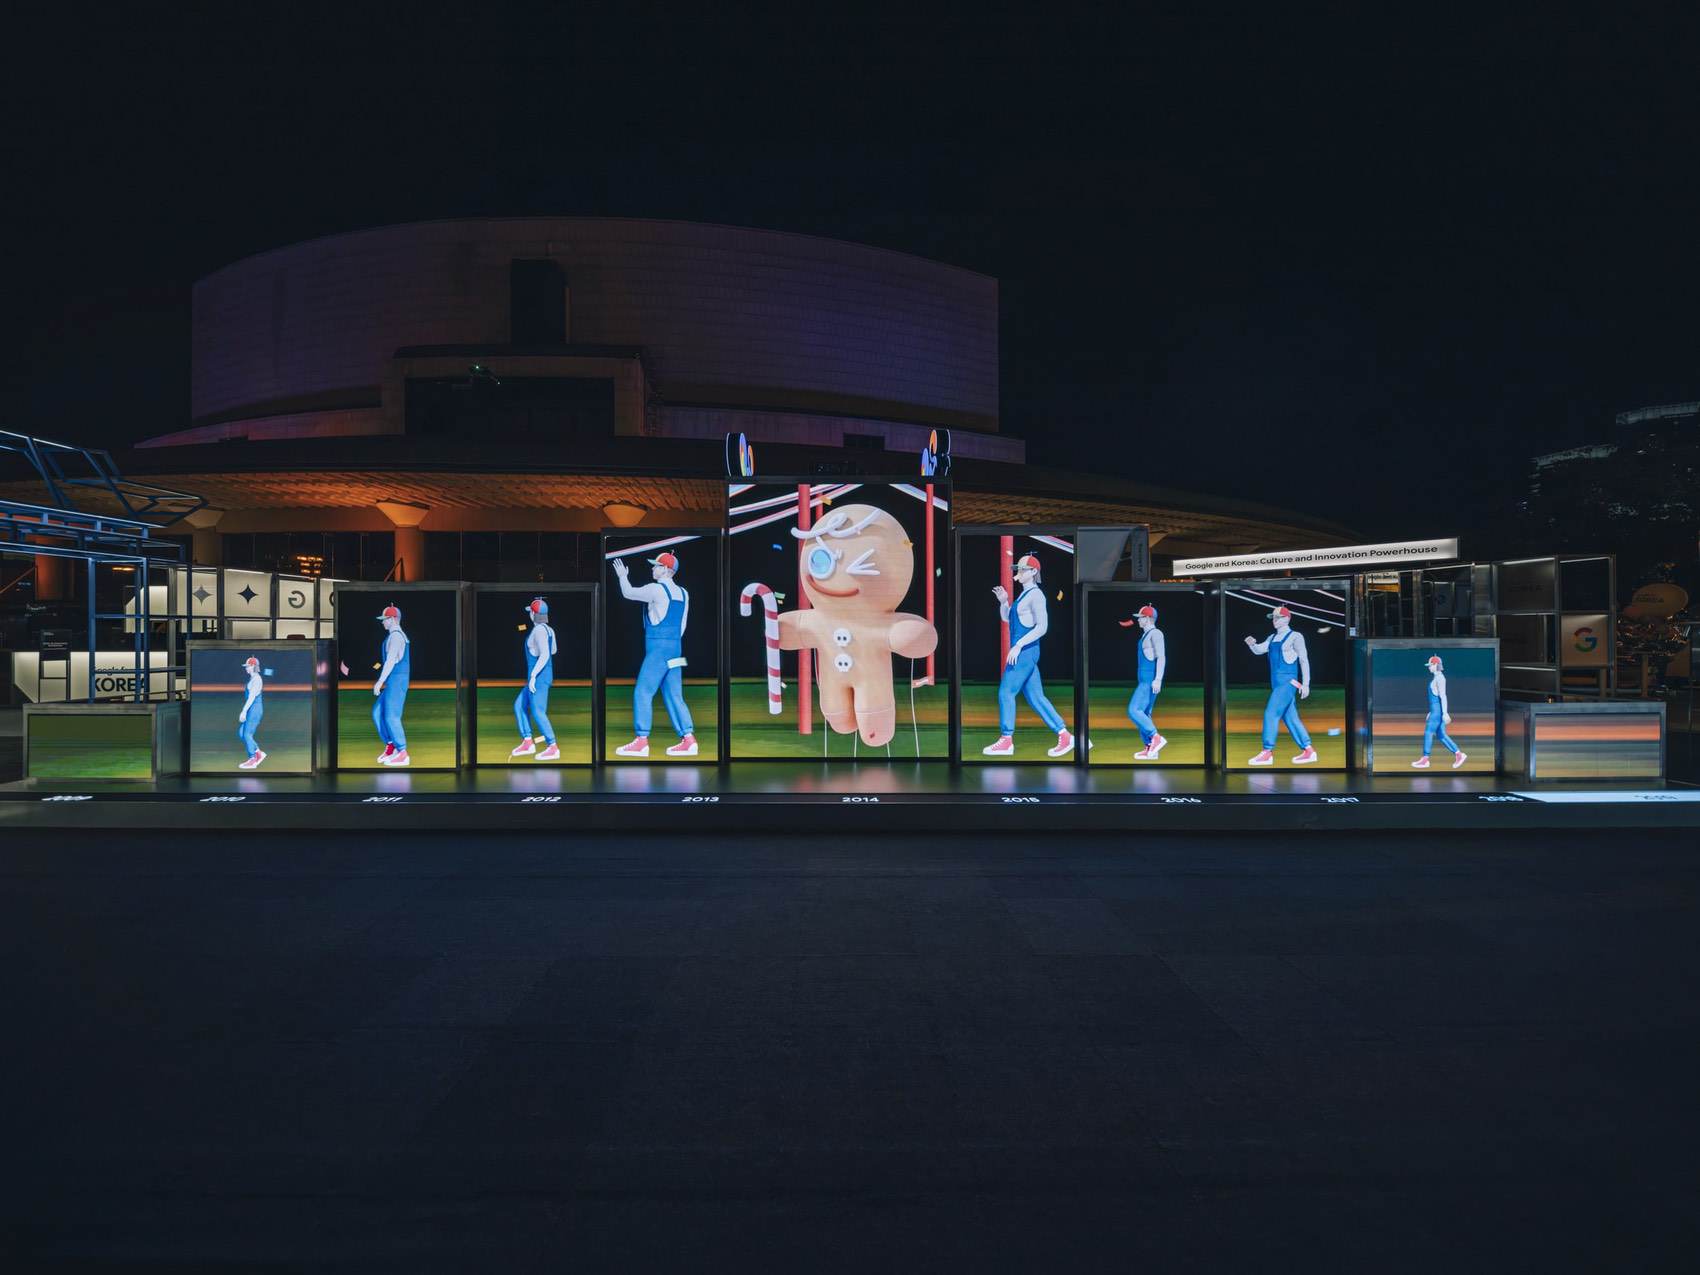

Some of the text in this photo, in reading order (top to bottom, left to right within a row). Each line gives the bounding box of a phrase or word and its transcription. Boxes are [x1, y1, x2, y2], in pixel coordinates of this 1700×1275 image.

[1185, 563, 1213, 571] Google
[1231, 558, 1258, 567] Korea:
[1260, 556, 1293, 565] Culture
[1295, 554, 1313, 562] and
[1315, 551, 1368, 561] Innovation
[1370, 546, 1438, 557] Powerhouse
